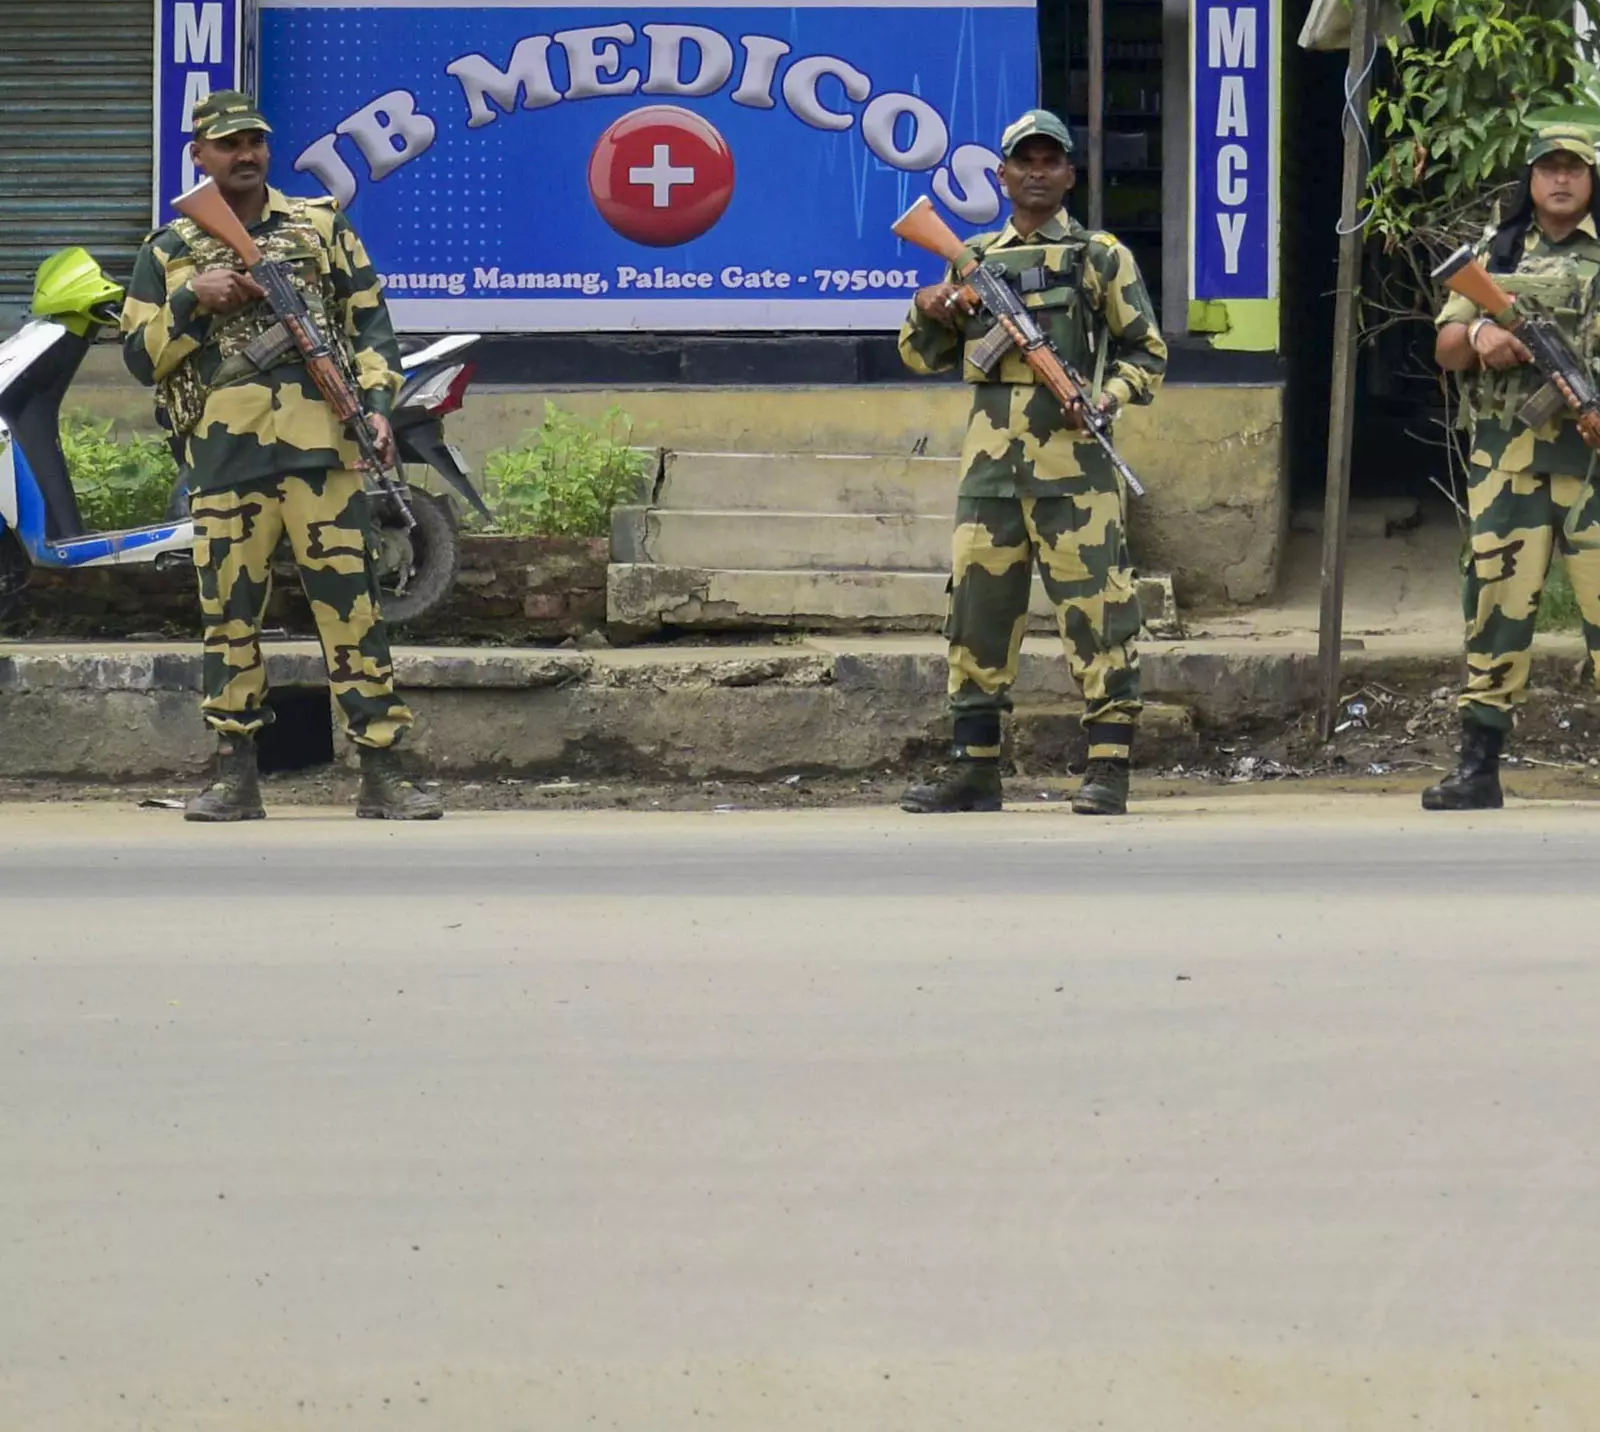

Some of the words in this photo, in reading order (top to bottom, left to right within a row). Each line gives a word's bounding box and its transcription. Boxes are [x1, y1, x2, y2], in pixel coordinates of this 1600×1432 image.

[293, 88, 439, 211] JB
[445, 21, 1010, 225] MEDICOS
[379, 271, 466, 297] onung
[473, 266, 609, 297] Mamang,
[617, 265, 713, 290] Palace
[720, 266, 790, 290] Gate
[814, 268, 920, 291] 795001
